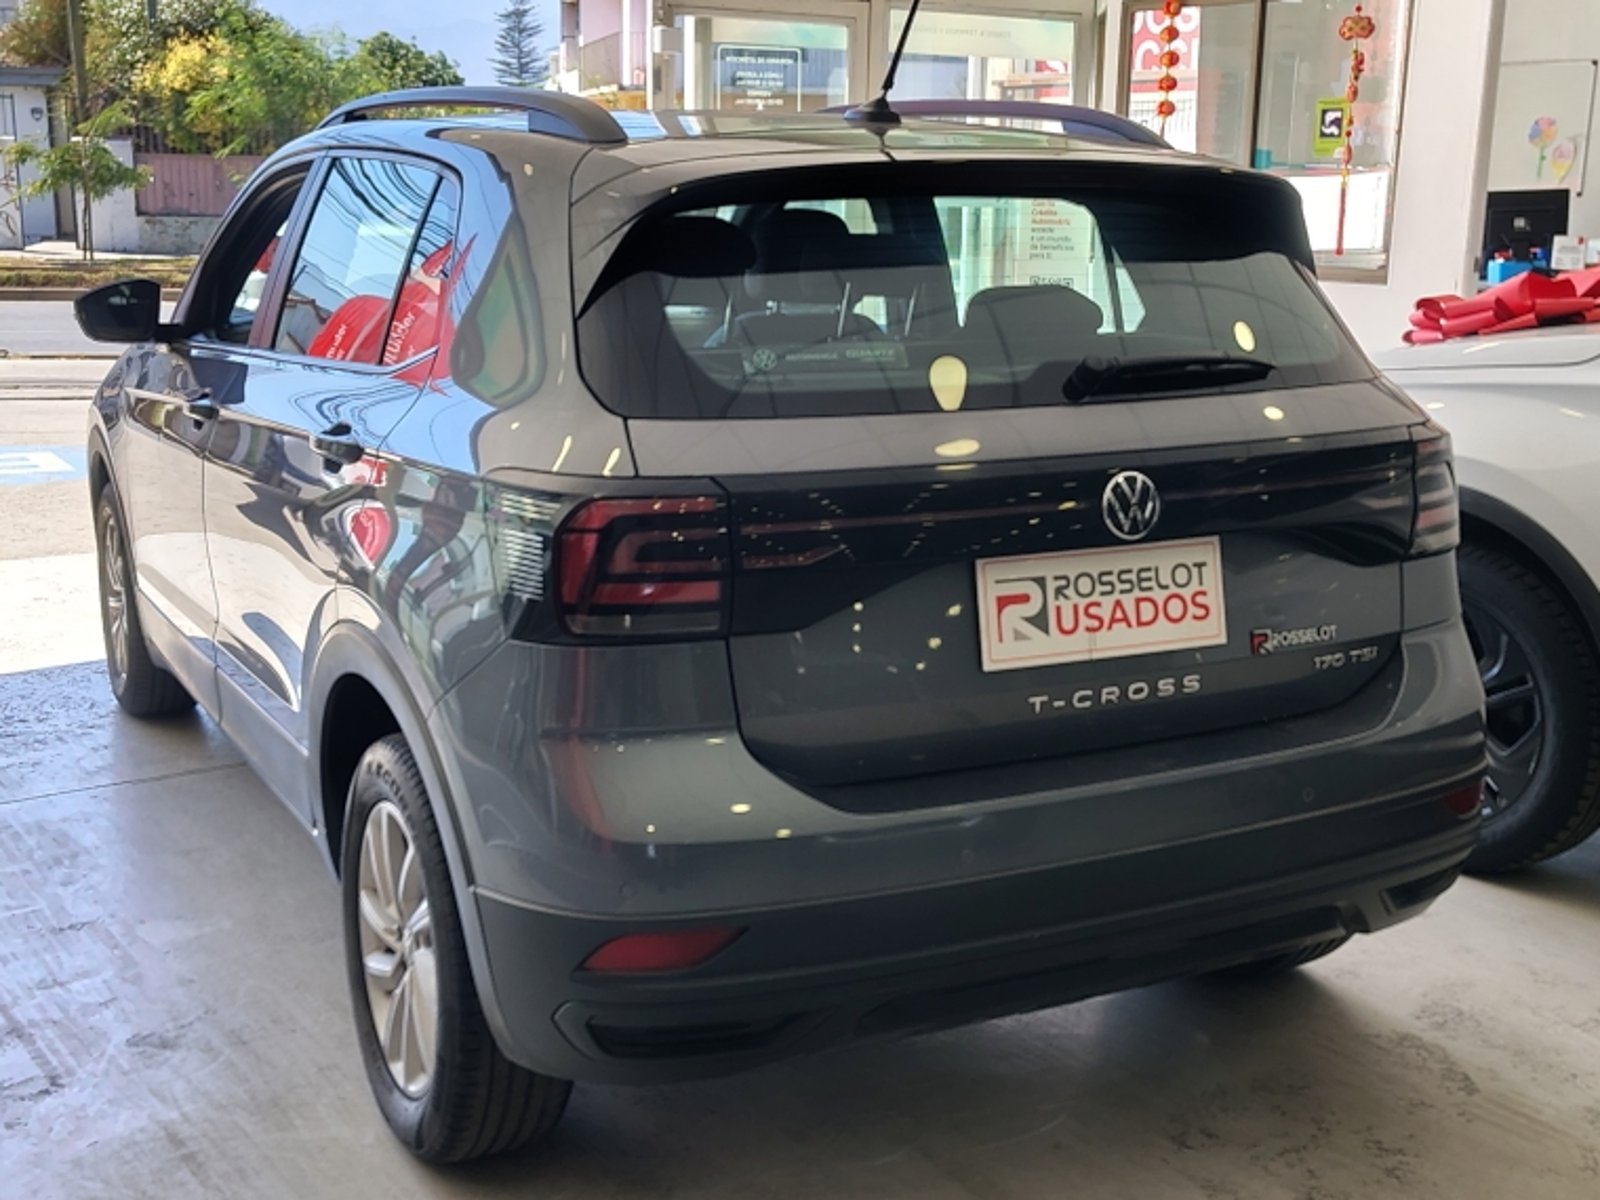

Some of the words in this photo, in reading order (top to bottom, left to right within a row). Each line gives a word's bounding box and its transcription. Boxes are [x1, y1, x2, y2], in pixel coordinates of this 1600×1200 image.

[1053, 561, 1208, 601] ROSSELOT
[1054, 590, 1211, 637] USADOS
[1272, 624, 1338, 649] ROSSELOT
[1313, 652, 1346, 670] 170
[1348, 645, 1379, 664] TSI
[1028, 675, 1201, 714] T-CROSS
